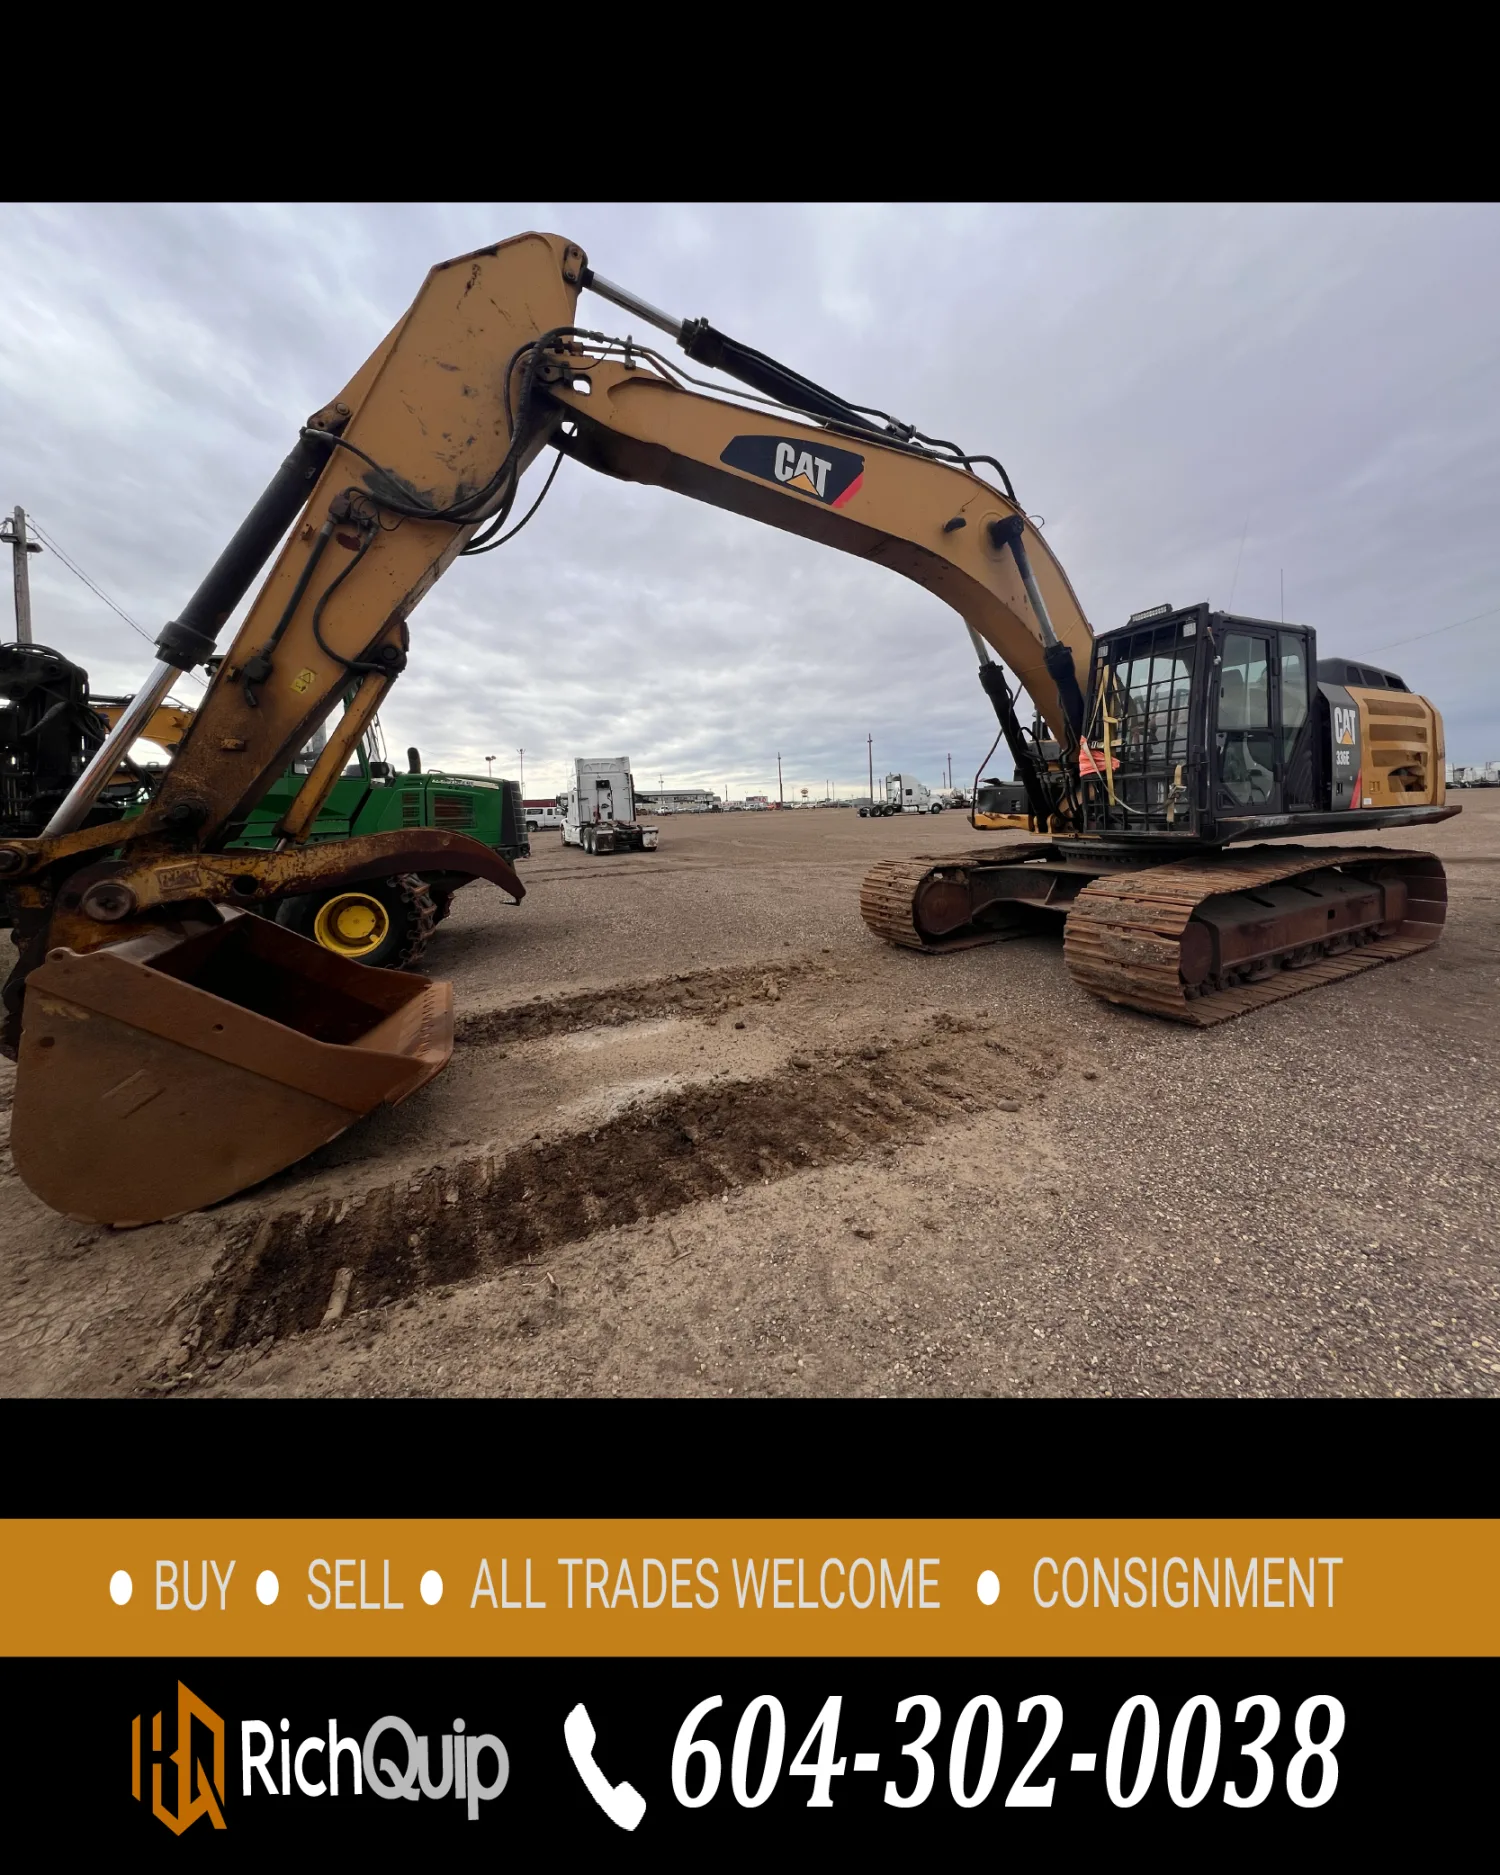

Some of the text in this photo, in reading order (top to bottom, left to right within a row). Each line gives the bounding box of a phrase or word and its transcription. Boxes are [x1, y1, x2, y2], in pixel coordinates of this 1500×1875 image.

[774, 442, 832, 498] CAT
[1334, 706, 1355, 745] CAT
[1335, 750, 1350, 765] 336E
